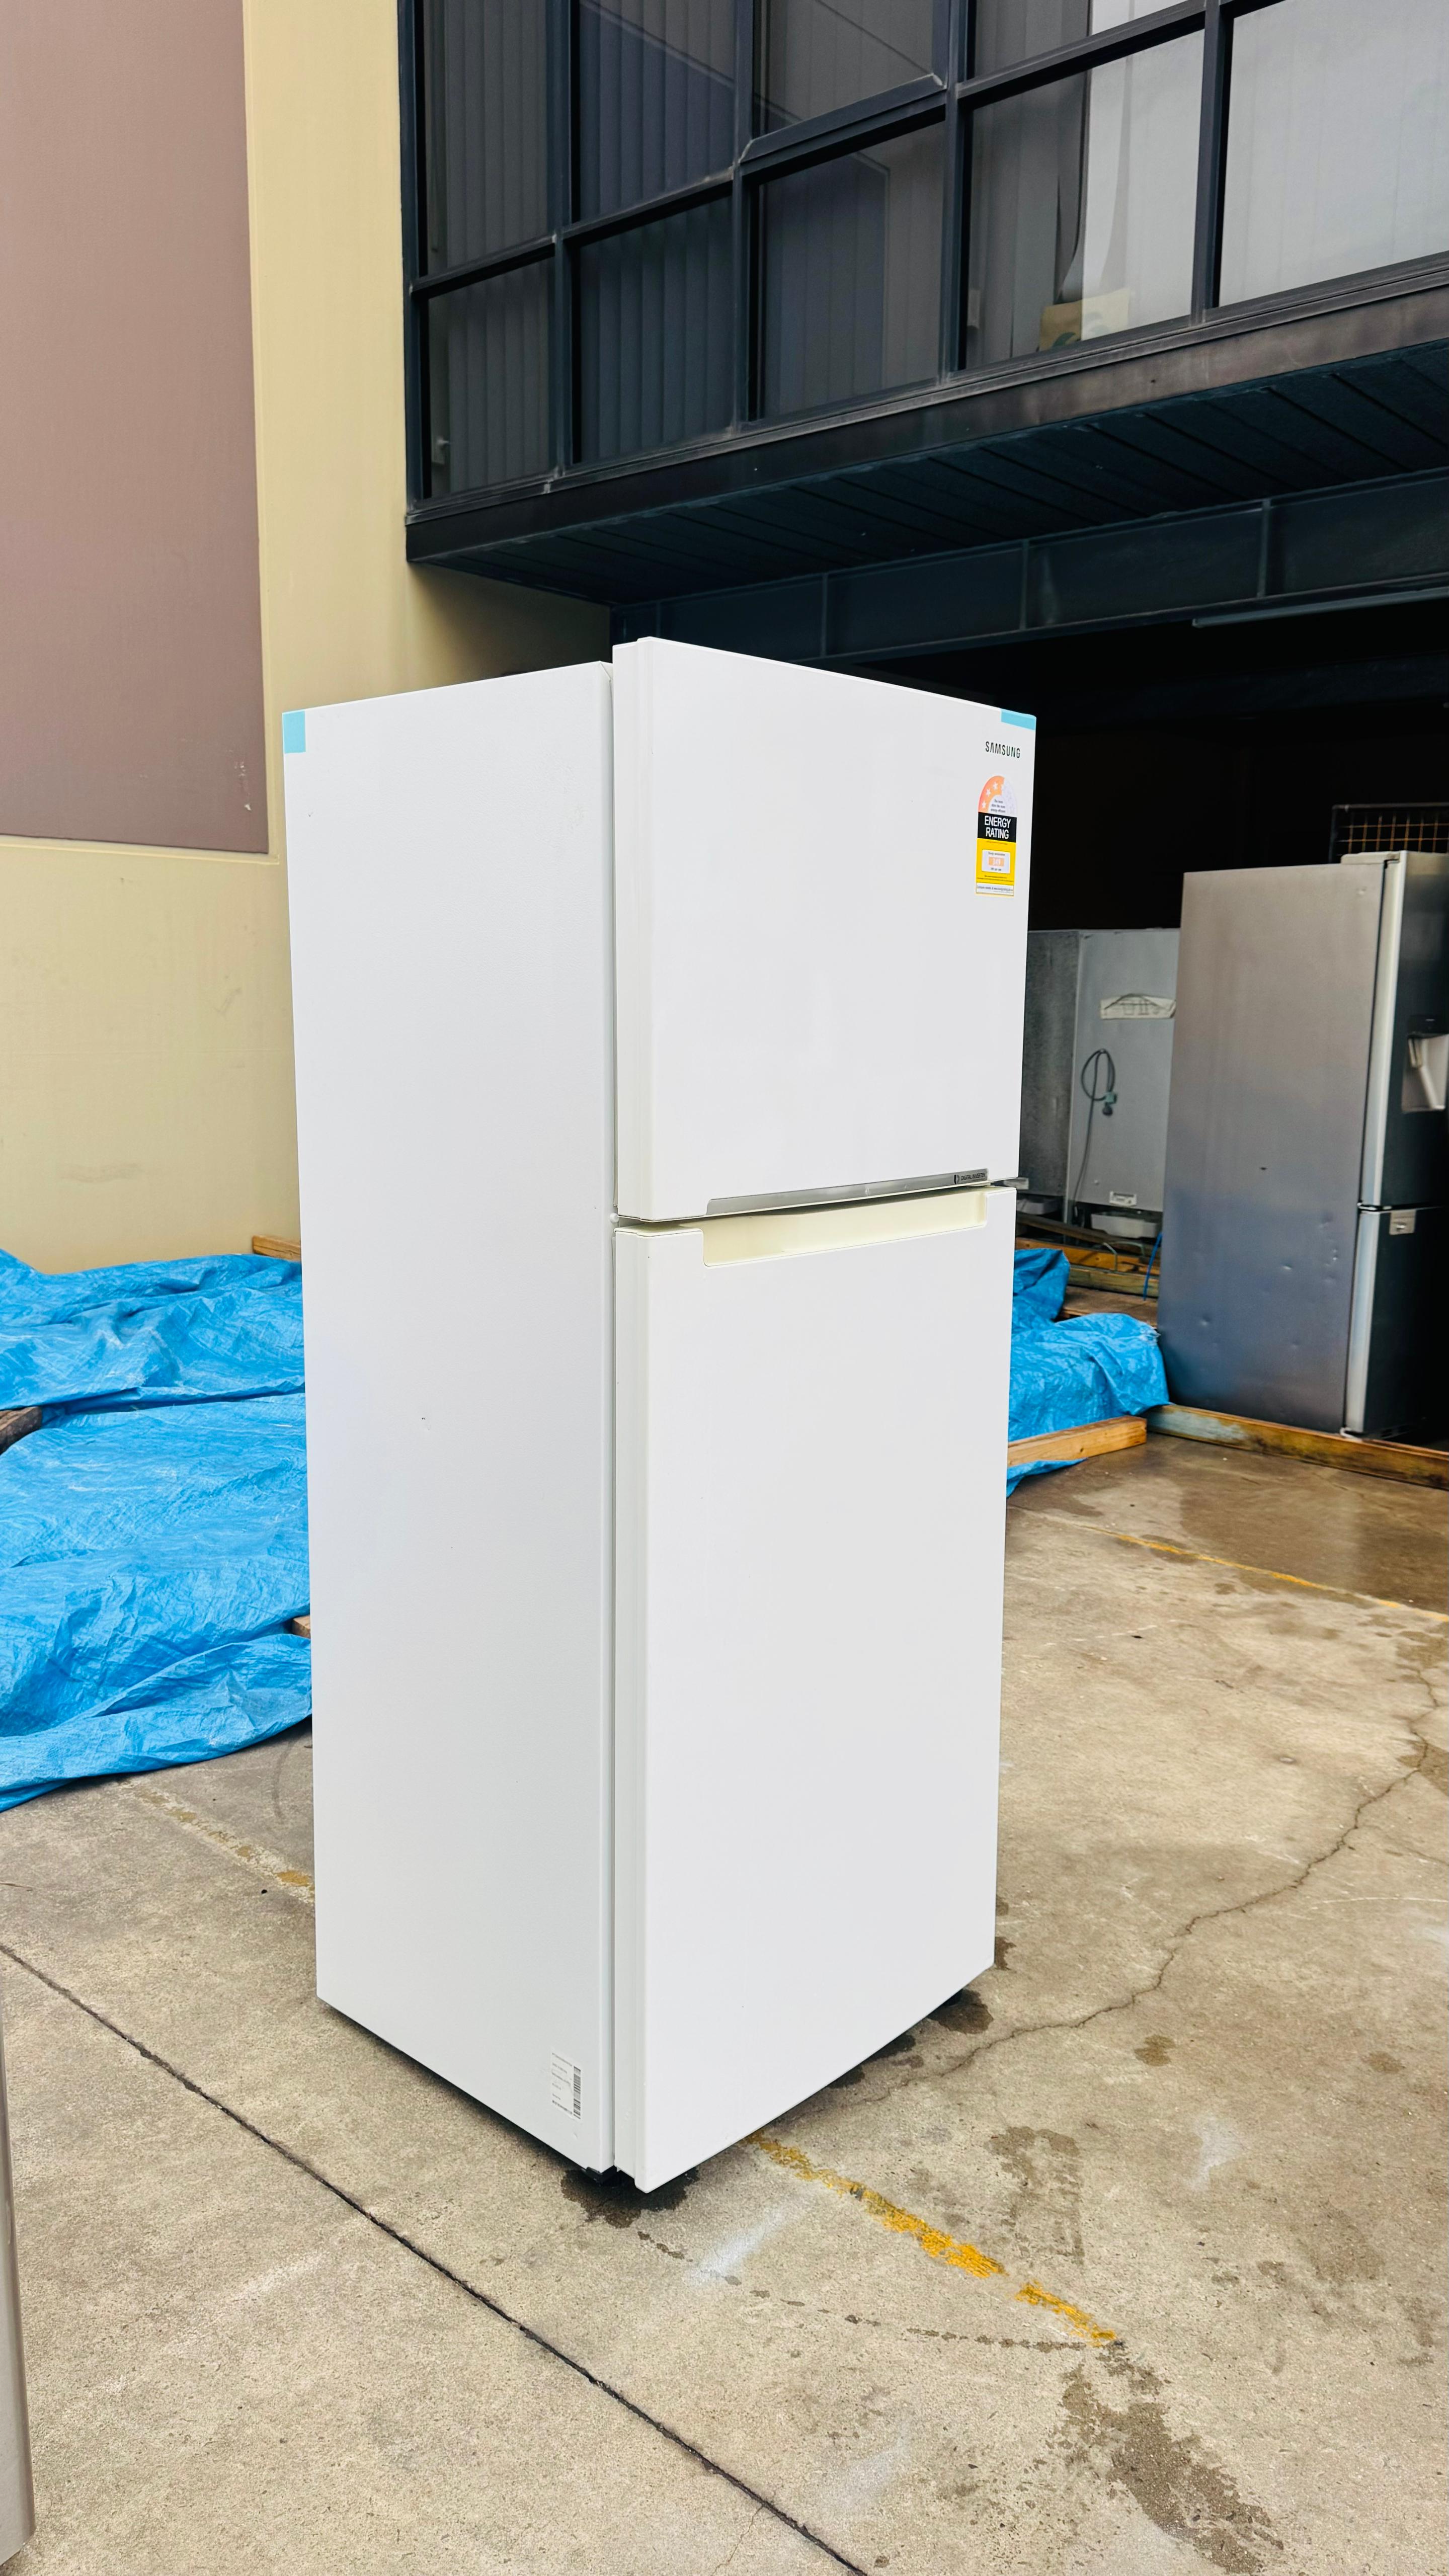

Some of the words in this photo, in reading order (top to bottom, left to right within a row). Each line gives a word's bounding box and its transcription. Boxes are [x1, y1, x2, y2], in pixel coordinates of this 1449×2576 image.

[985, 741, 1020, 758] SAMSUNG
[984, 815, 1011, 828] ENERGY
[986, 827, 1009, 840] RATING
